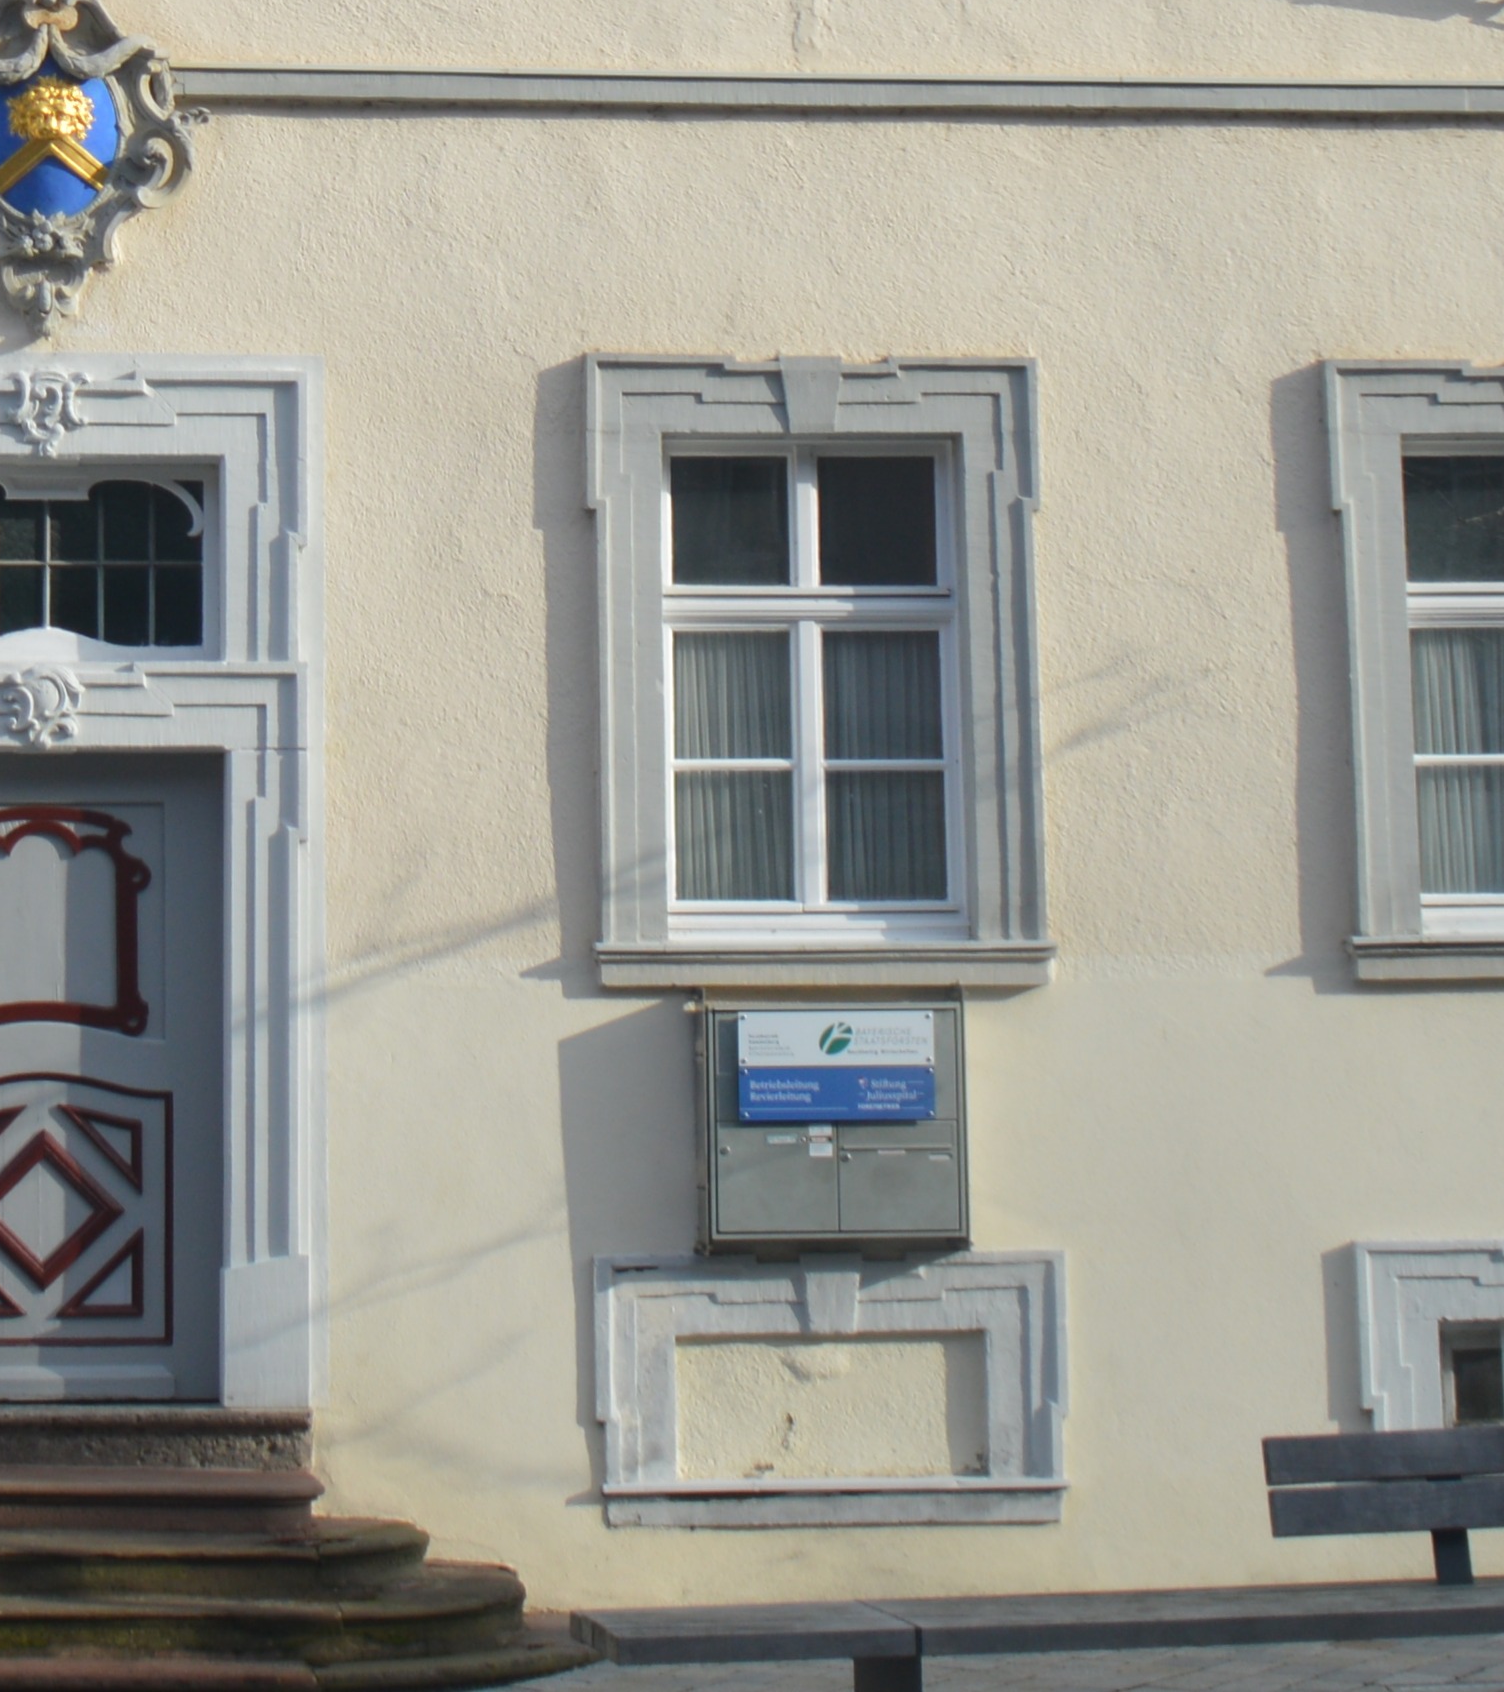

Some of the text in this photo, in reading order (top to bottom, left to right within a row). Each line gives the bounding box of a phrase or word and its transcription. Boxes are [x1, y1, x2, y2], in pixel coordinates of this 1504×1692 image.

[750, 1079, 820, 1092] Betriebsleitung
[871, 1078, 907, 1091] Stiftung
[750, 1092, 812, 1103] Revierleitung
[866, 1089, 917, 1102] Juliusspital
